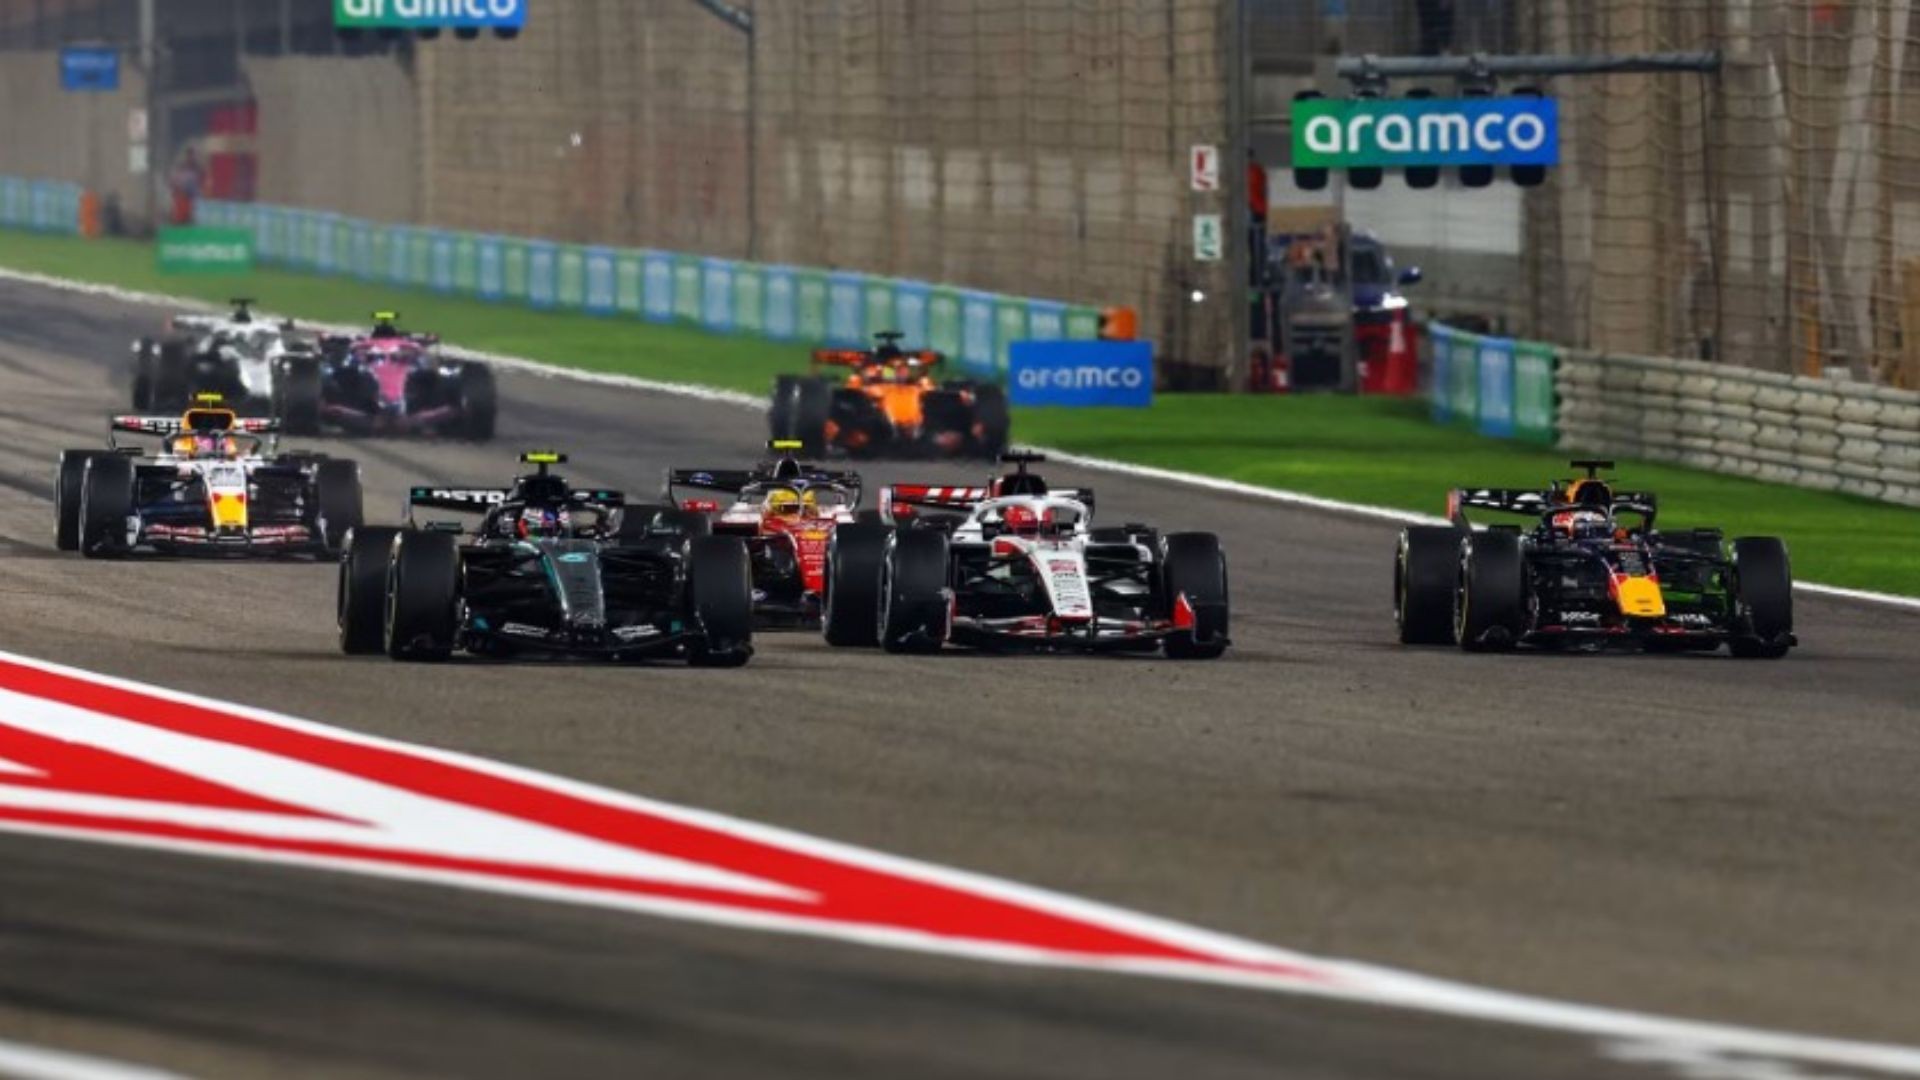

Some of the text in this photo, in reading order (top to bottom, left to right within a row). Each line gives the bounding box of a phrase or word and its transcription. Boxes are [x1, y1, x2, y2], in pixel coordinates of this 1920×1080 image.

[343, 0, 517, 18] aramco
[1304, 112, 1546, 153] aramco
[1018, 366, 1142, 388] aramco
